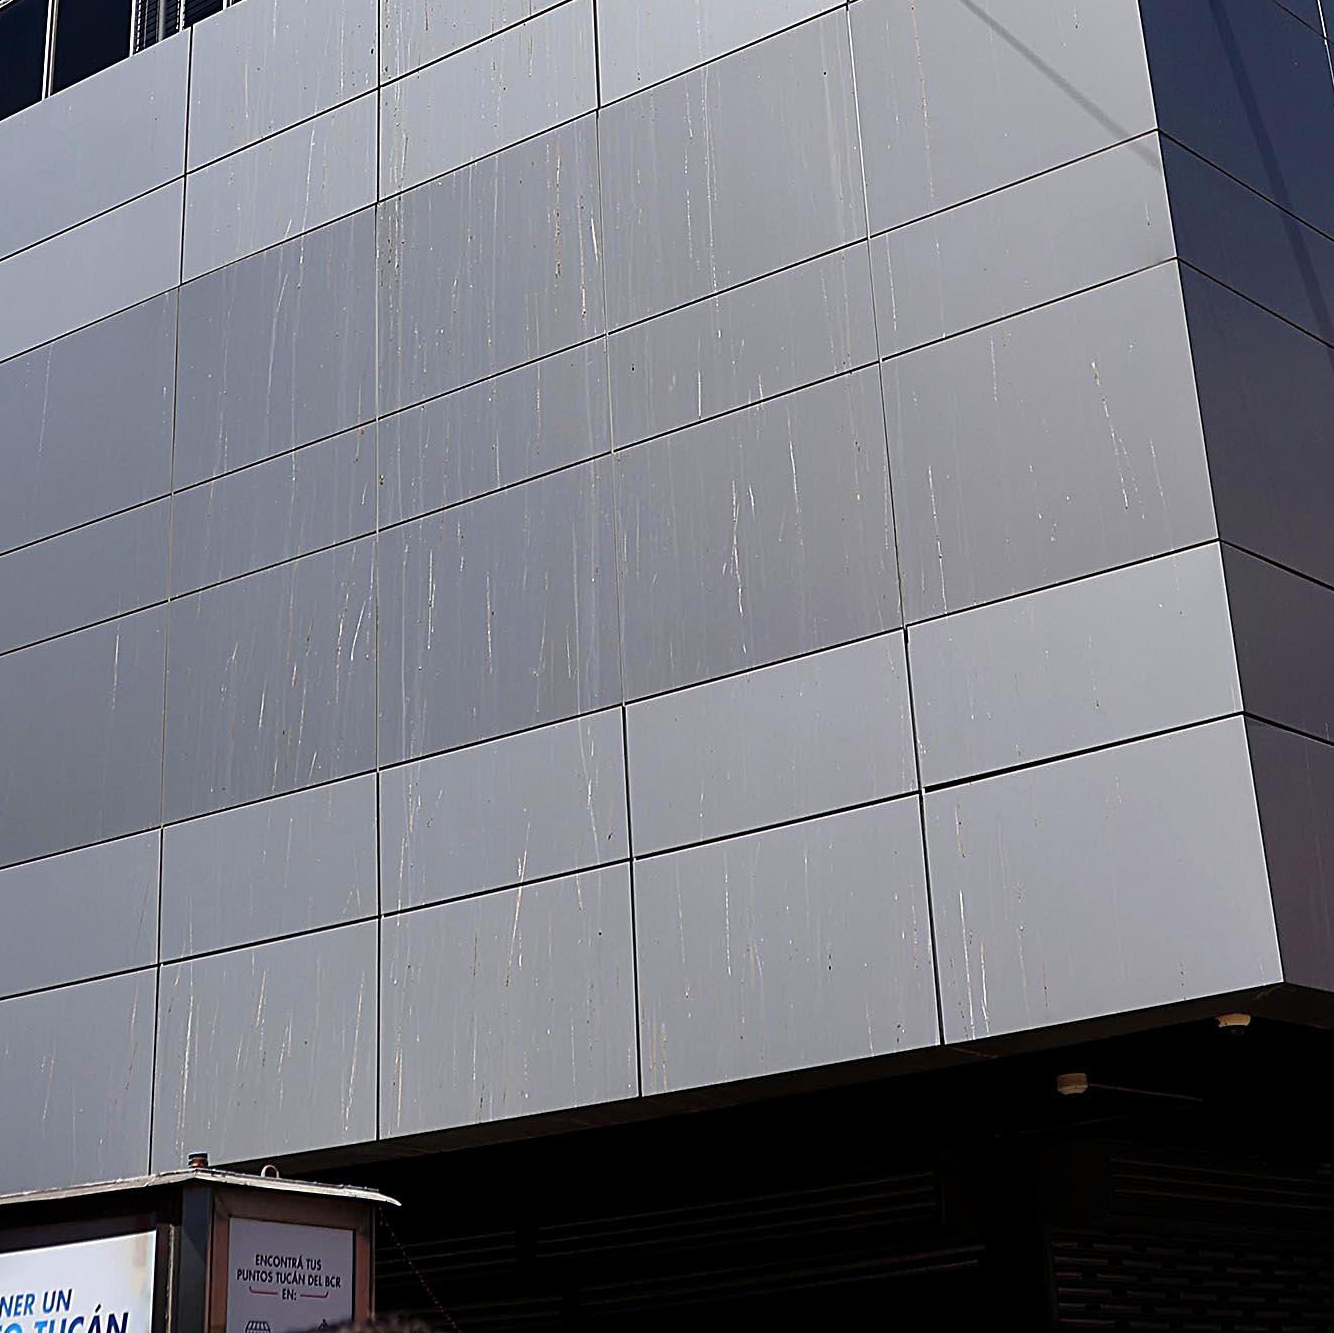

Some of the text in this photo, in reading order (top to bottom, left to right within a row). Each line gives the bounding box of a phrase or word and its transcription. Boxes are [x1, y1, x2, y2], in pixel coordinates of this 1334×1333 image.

[255, 1254, 322, 1271] ENCONTRÁ TUS
[236, 1268, 341, 1288] PUNTOS TUCÁN DEL BCR
[42, 1288, 73, 1314] UN
[281, 1288, 297, 1301] EN:
